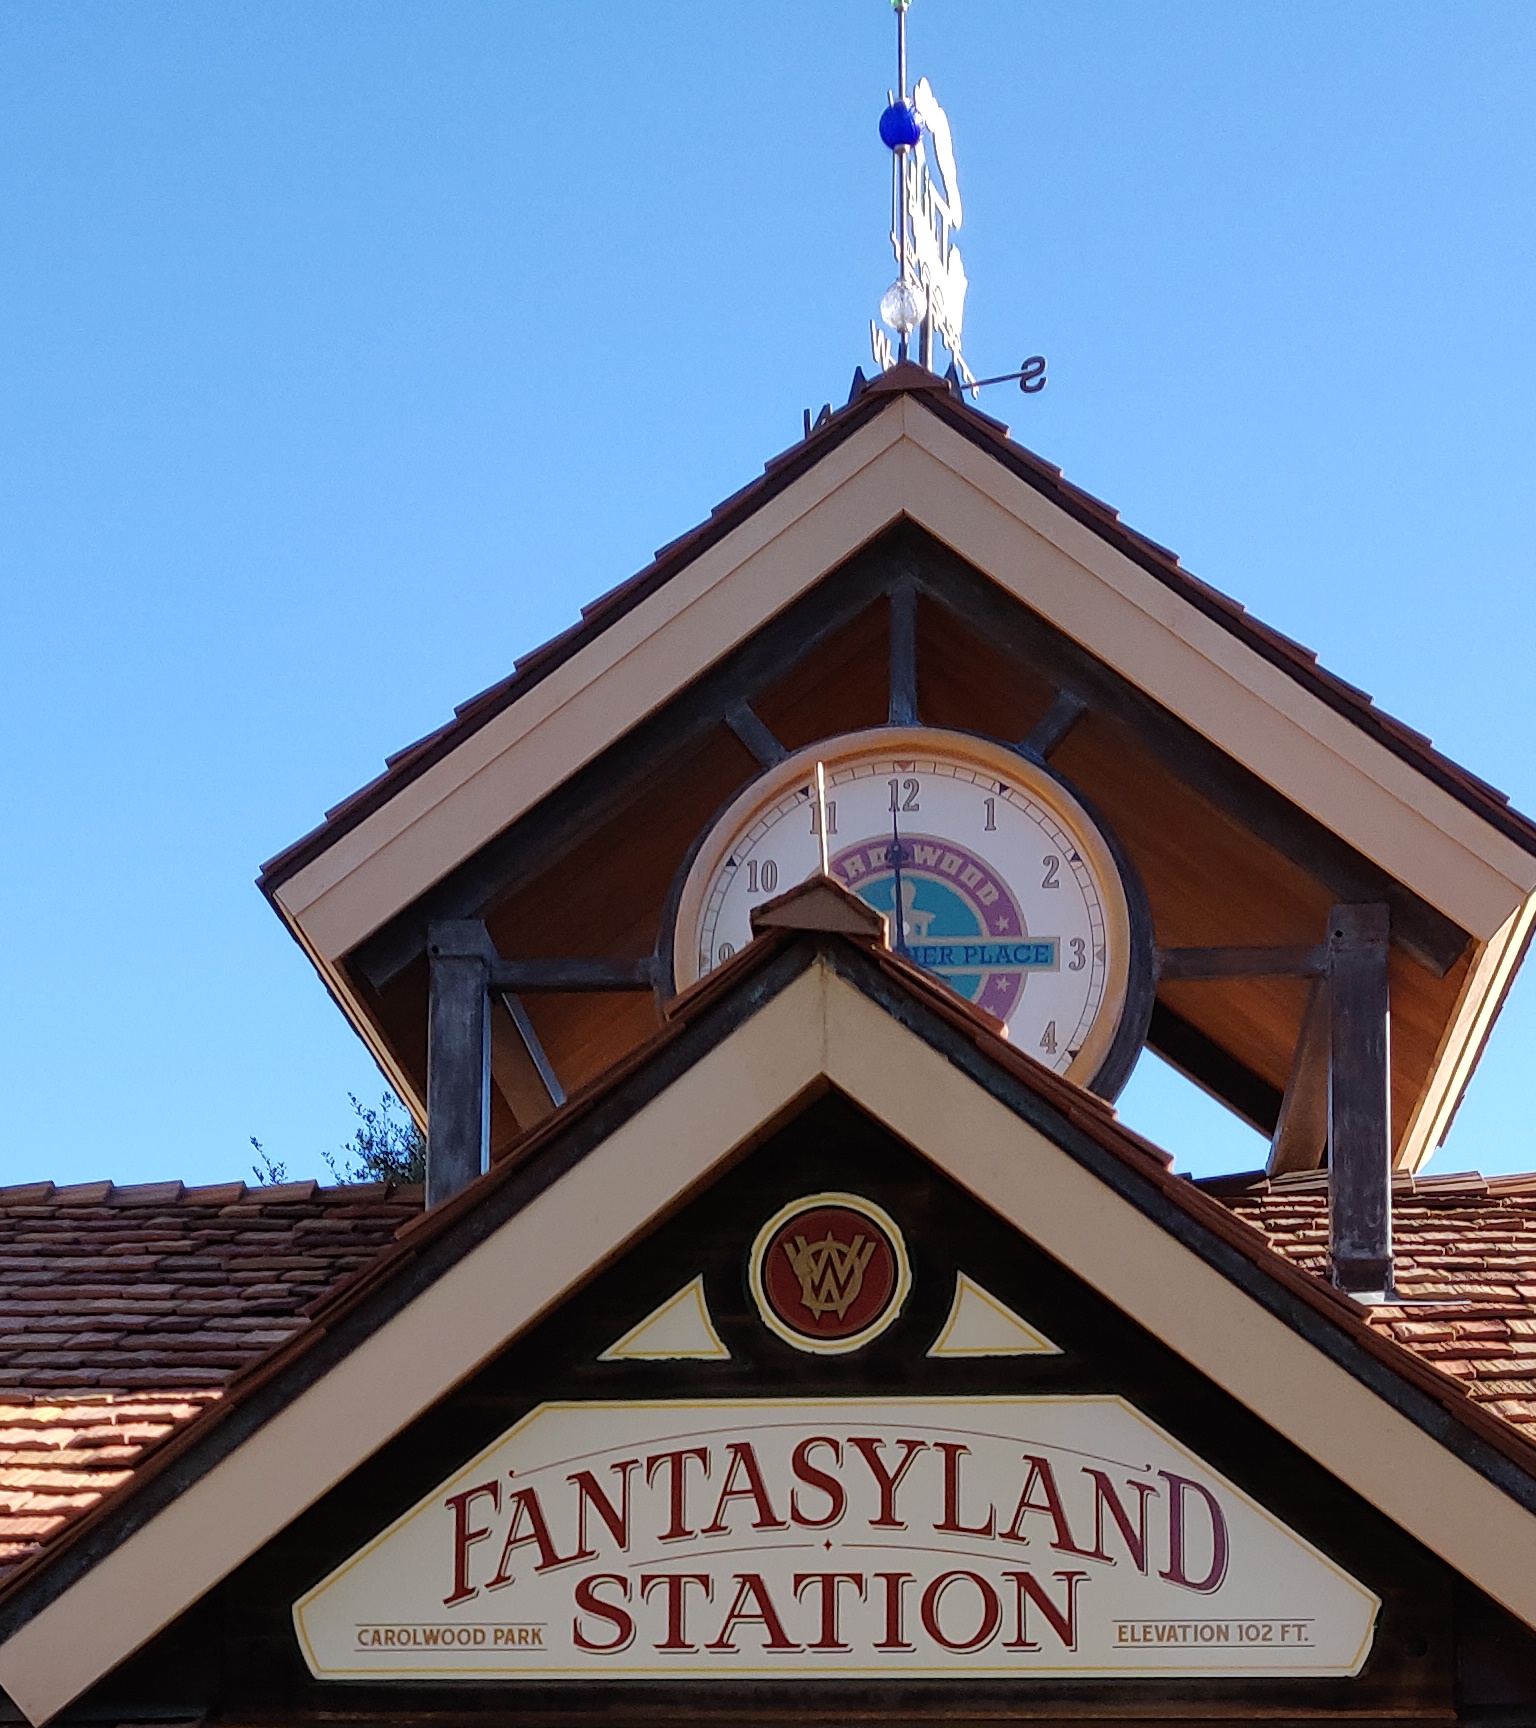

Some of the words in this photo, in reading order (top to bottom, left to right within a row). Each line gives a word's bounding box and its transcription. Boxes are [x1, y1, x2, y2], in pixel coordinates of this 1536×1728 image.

[888, 778, 920, 812] 12
[809, 801, 838, 835] 11
[984, 798, 996, 831] 1
[746, 859, 778, 893] 10
[1042, 855, 1060, 889] 2
[964, 943, 1050, 966] PLACE
[1068, 937, 1087, 971] 3
[1039, 1021, 1058, 1055] 4
[443, 1436, 1230, 1608] FANTASYLAND
[573, 1569, 1091, 1656] STATION
[356, 1627, 487, 1647] CAROLWOOD
[493, 1627, 544, 1646] PARK
[1117, 1623, 1230, 1643] ELEVATION
[1237, 1623, 1273, 1642] 102
[1280, 1623, 1309, 1642] FT.
